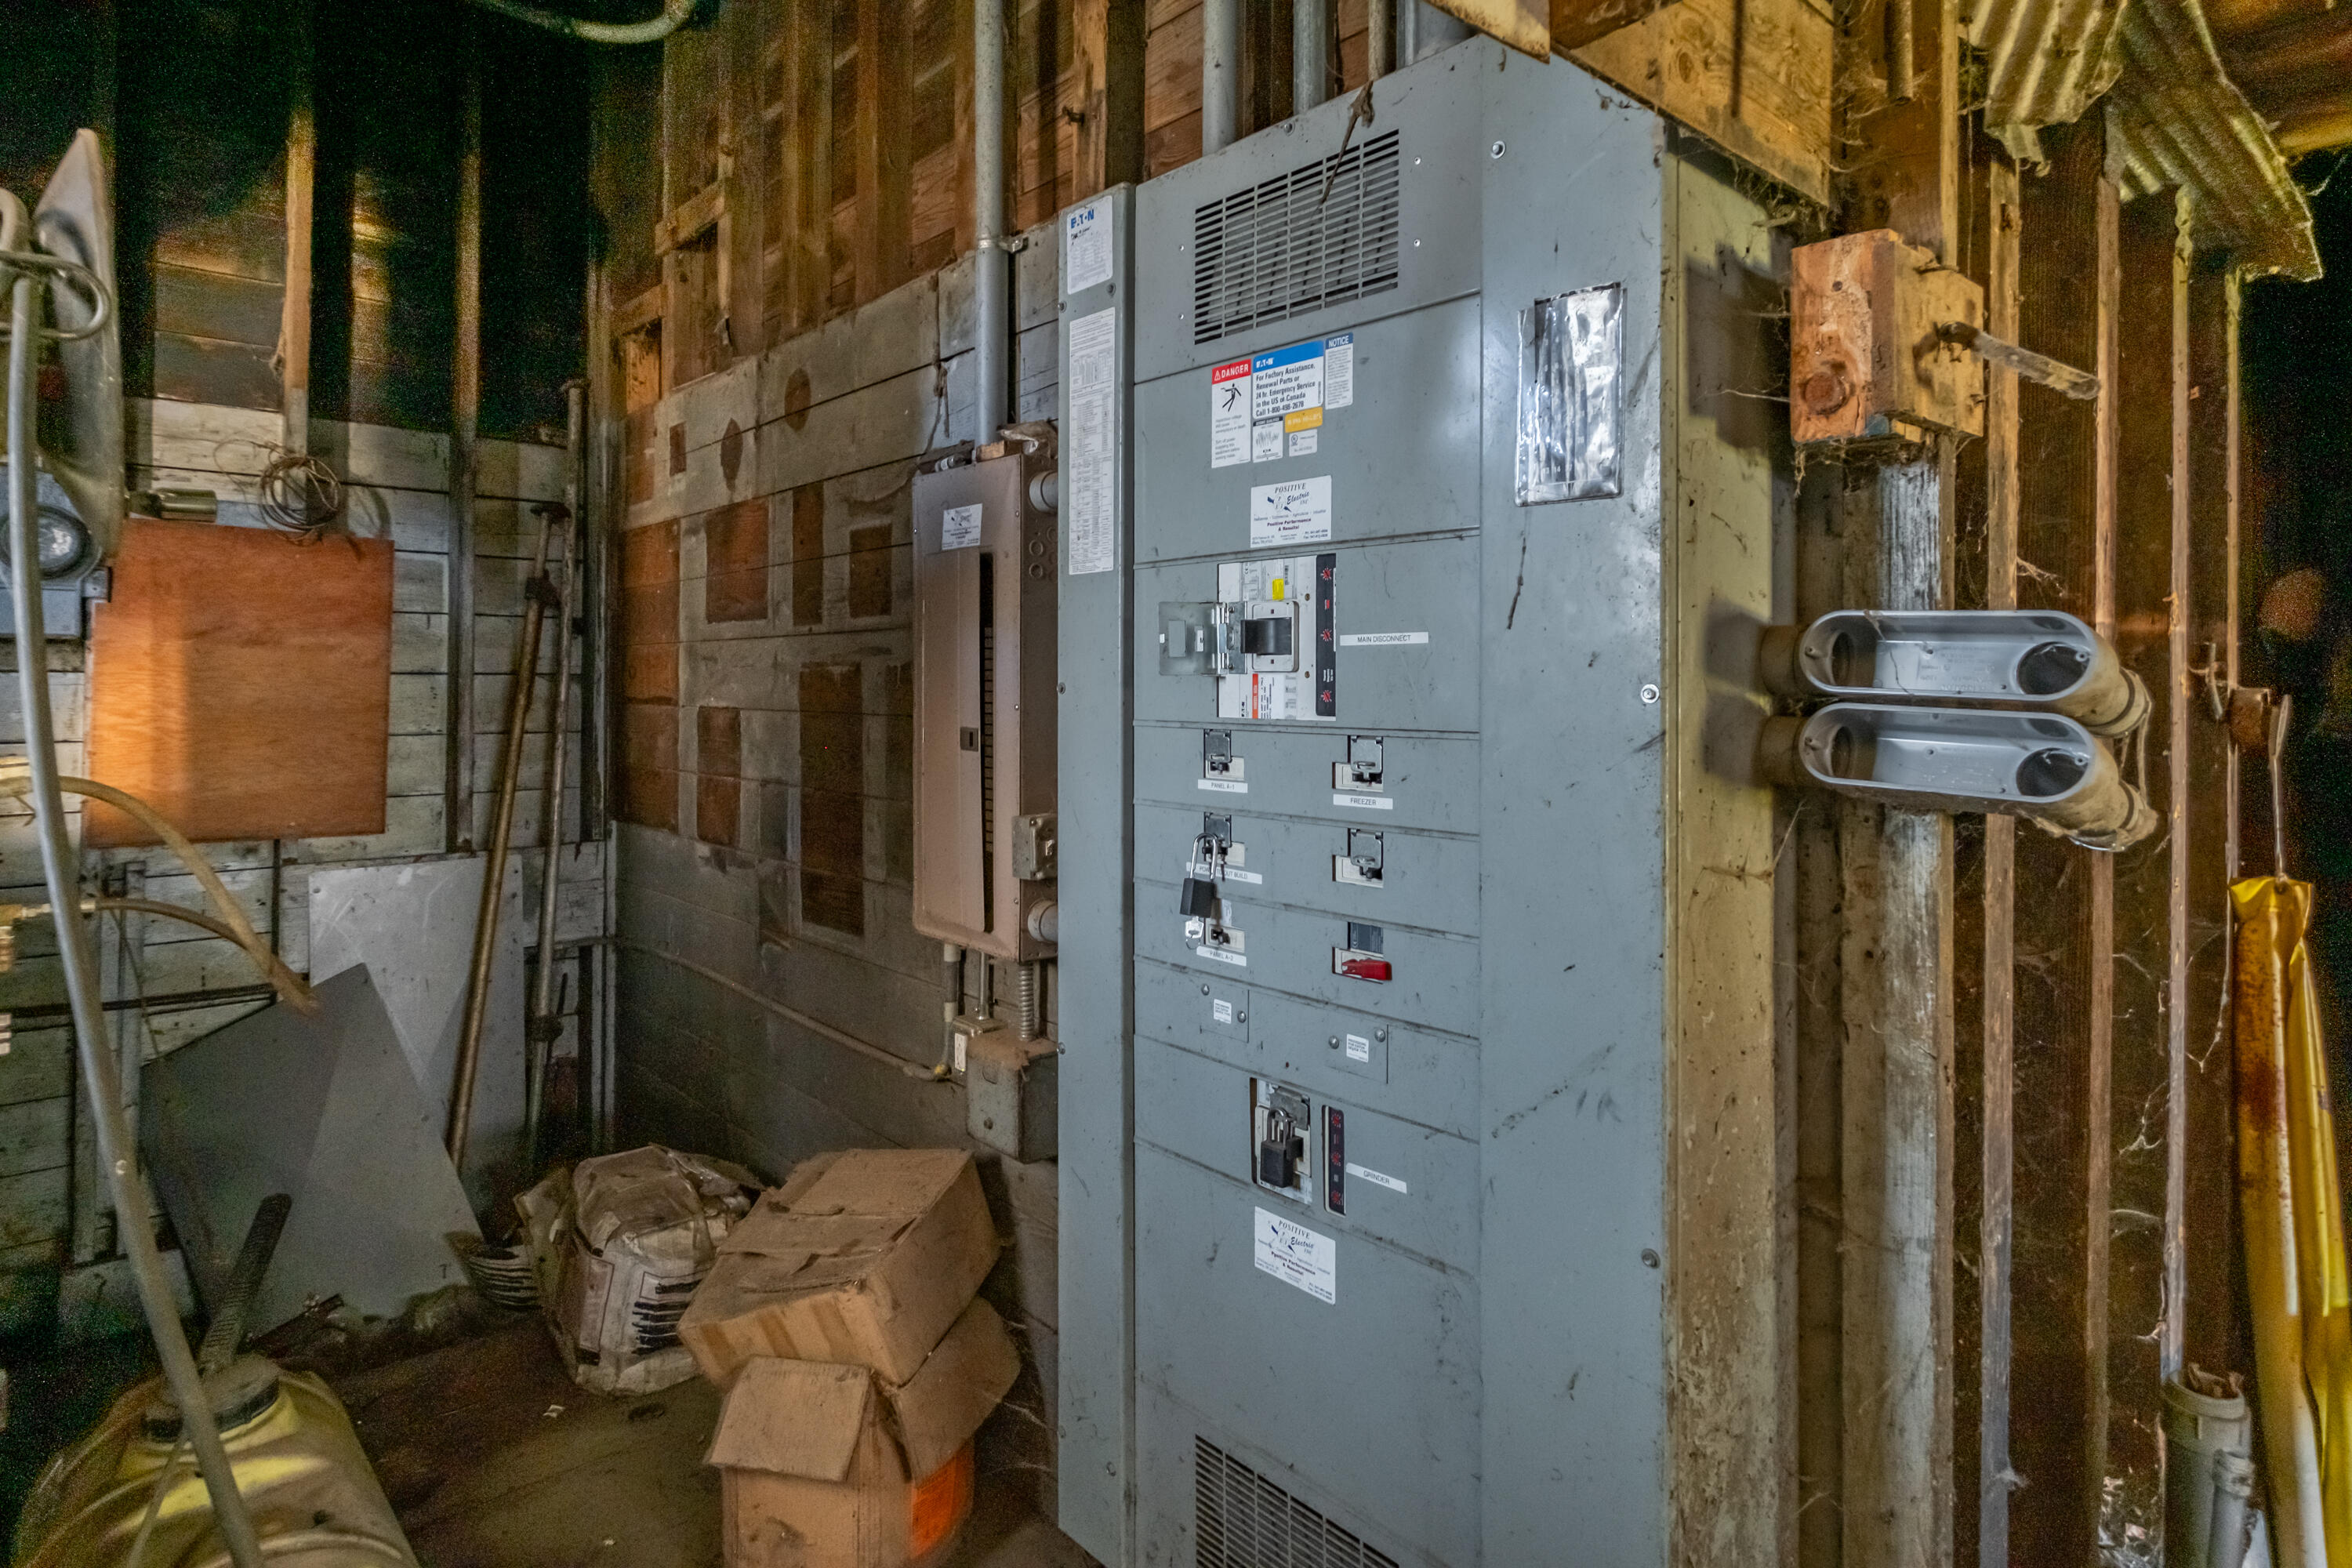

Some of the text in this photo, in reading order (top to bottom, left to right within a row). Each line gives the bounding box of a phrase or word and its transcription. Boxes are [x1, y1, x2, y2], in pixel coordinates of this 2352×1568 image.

[1328, 336, 1349, 347] NOTICE
[1221, 363, 1249, 379] DANGER
[1265, 370, 1284, 379] Factory
[1256, 379, 1278, 390] Renewal
[1270, 386, 1295, 396] Emergency
[1297, 381, 1316, 390] Service
[1286, 392, 1306, 401] Canada
[1275, 483, 1306, 493] POSITIVE
[1287, 491, 1309, 505] Electric
[1279, 1220, 1310, 1239] POSITIVE
[1290, 1237, 1314, 1248] Electric
